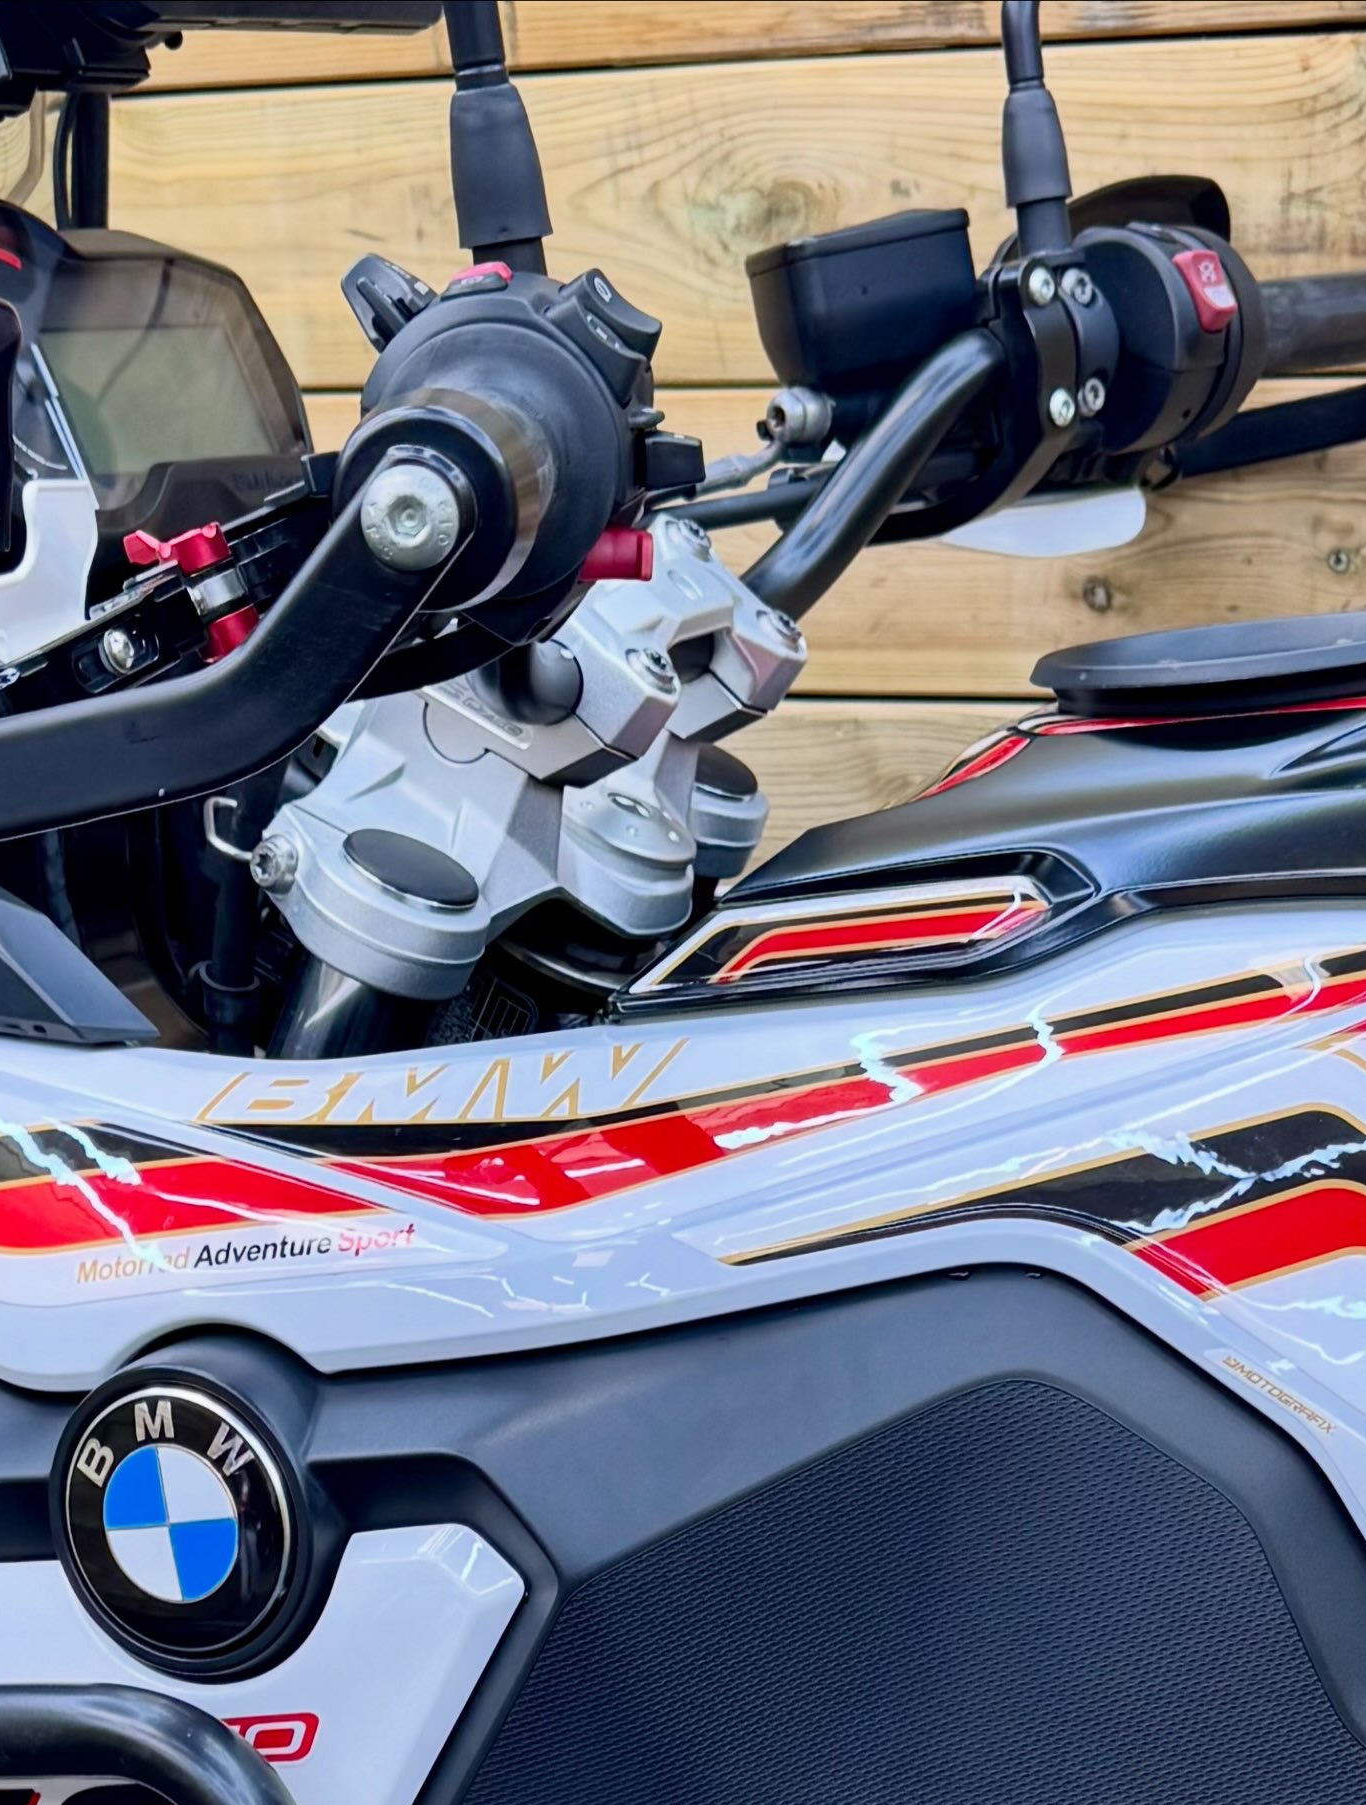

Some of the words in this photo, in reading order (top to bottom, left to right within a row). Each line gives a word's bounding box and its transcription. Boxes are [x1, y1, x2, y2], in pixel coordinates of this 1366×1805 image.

[196, 1036, 690, 1125] BMW
[193, 1233, 332, 1269] Adventure
[337, 1222, 416, 1257] Sport
[1233, 1361, 1337, 1435] MOTOGRAFIX
[77, 1399, 254, 1489] BMW
